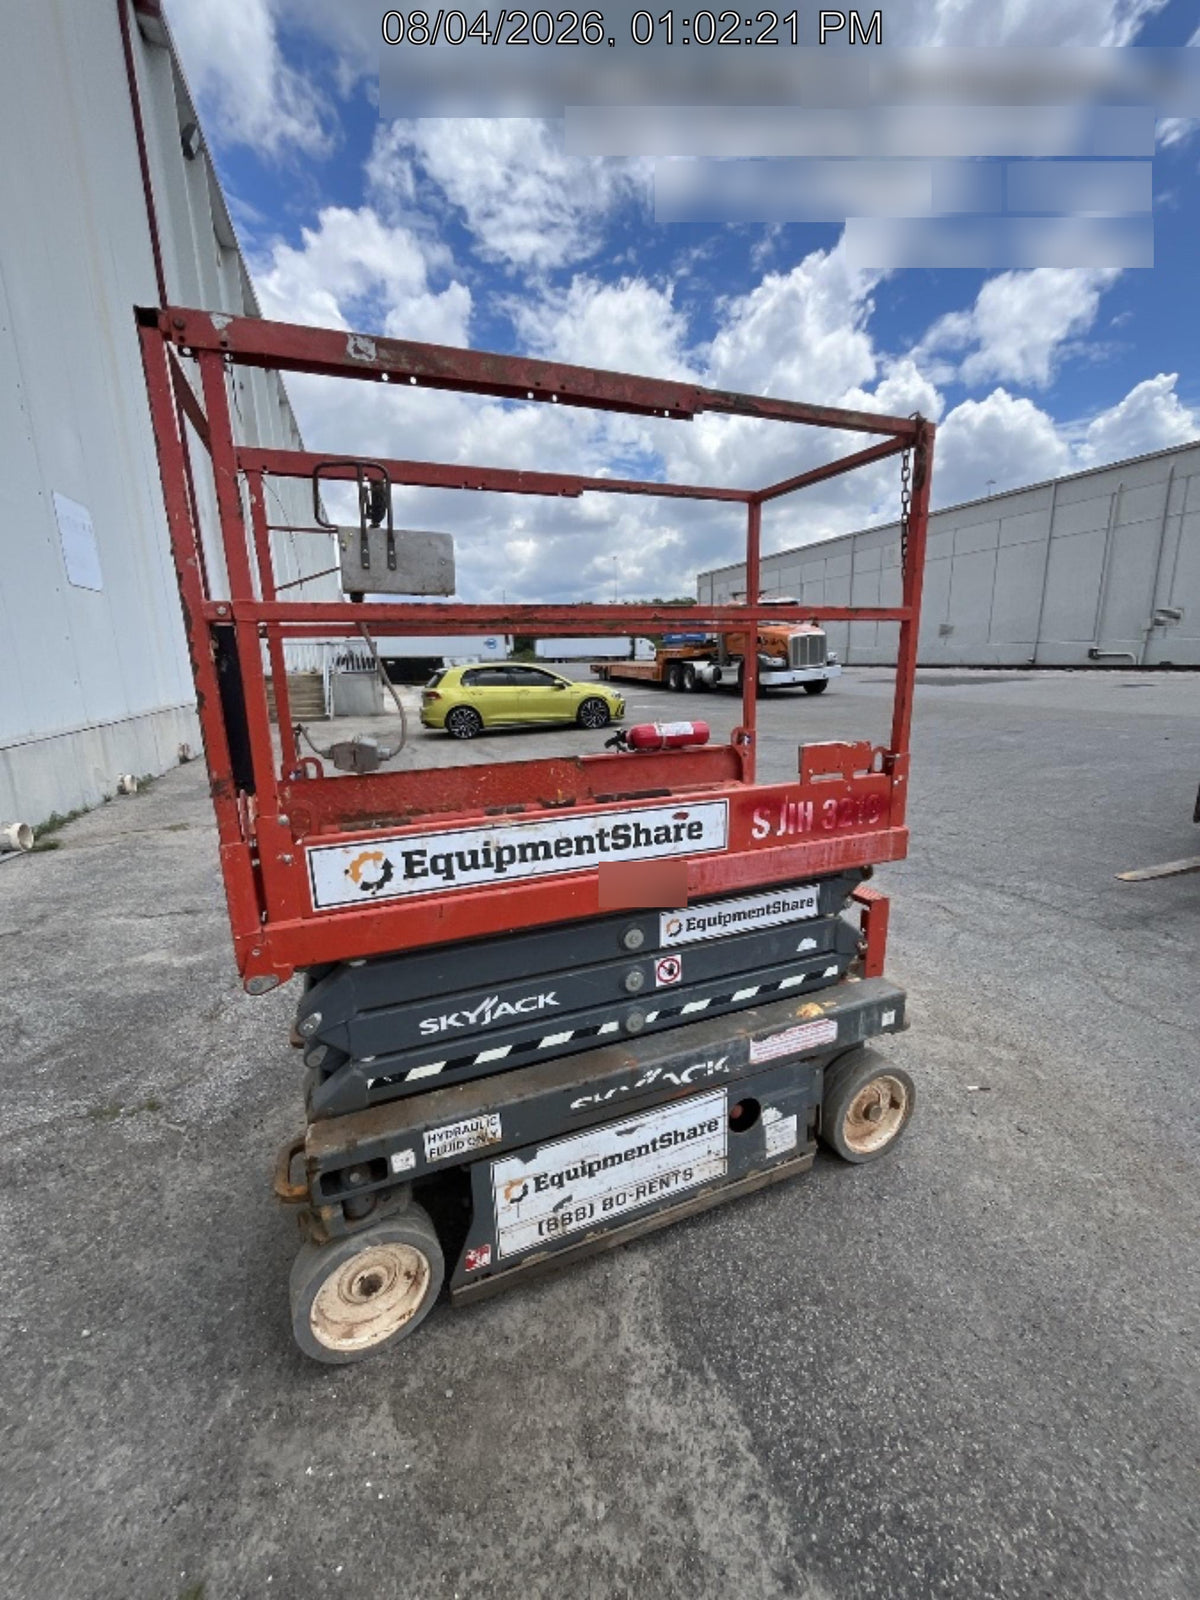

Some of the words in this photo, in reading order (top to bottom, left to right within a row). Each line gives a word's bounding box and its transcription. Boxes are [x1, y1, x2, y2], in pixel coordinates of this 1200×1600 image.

[401, 819, 703, 880] EquipmentShare
[686, 897, 814, 932] EquipmentShare
[419, 991, 560, 1035] SKYJACK
[428, 1116, 497, 1145] HYDRAULIC
[533, 1119, 719, 1194] EquipmentShare
[538, 1204, 595, 1236] (888)
[602, 1167, 694, 1212] 80-RENTS
